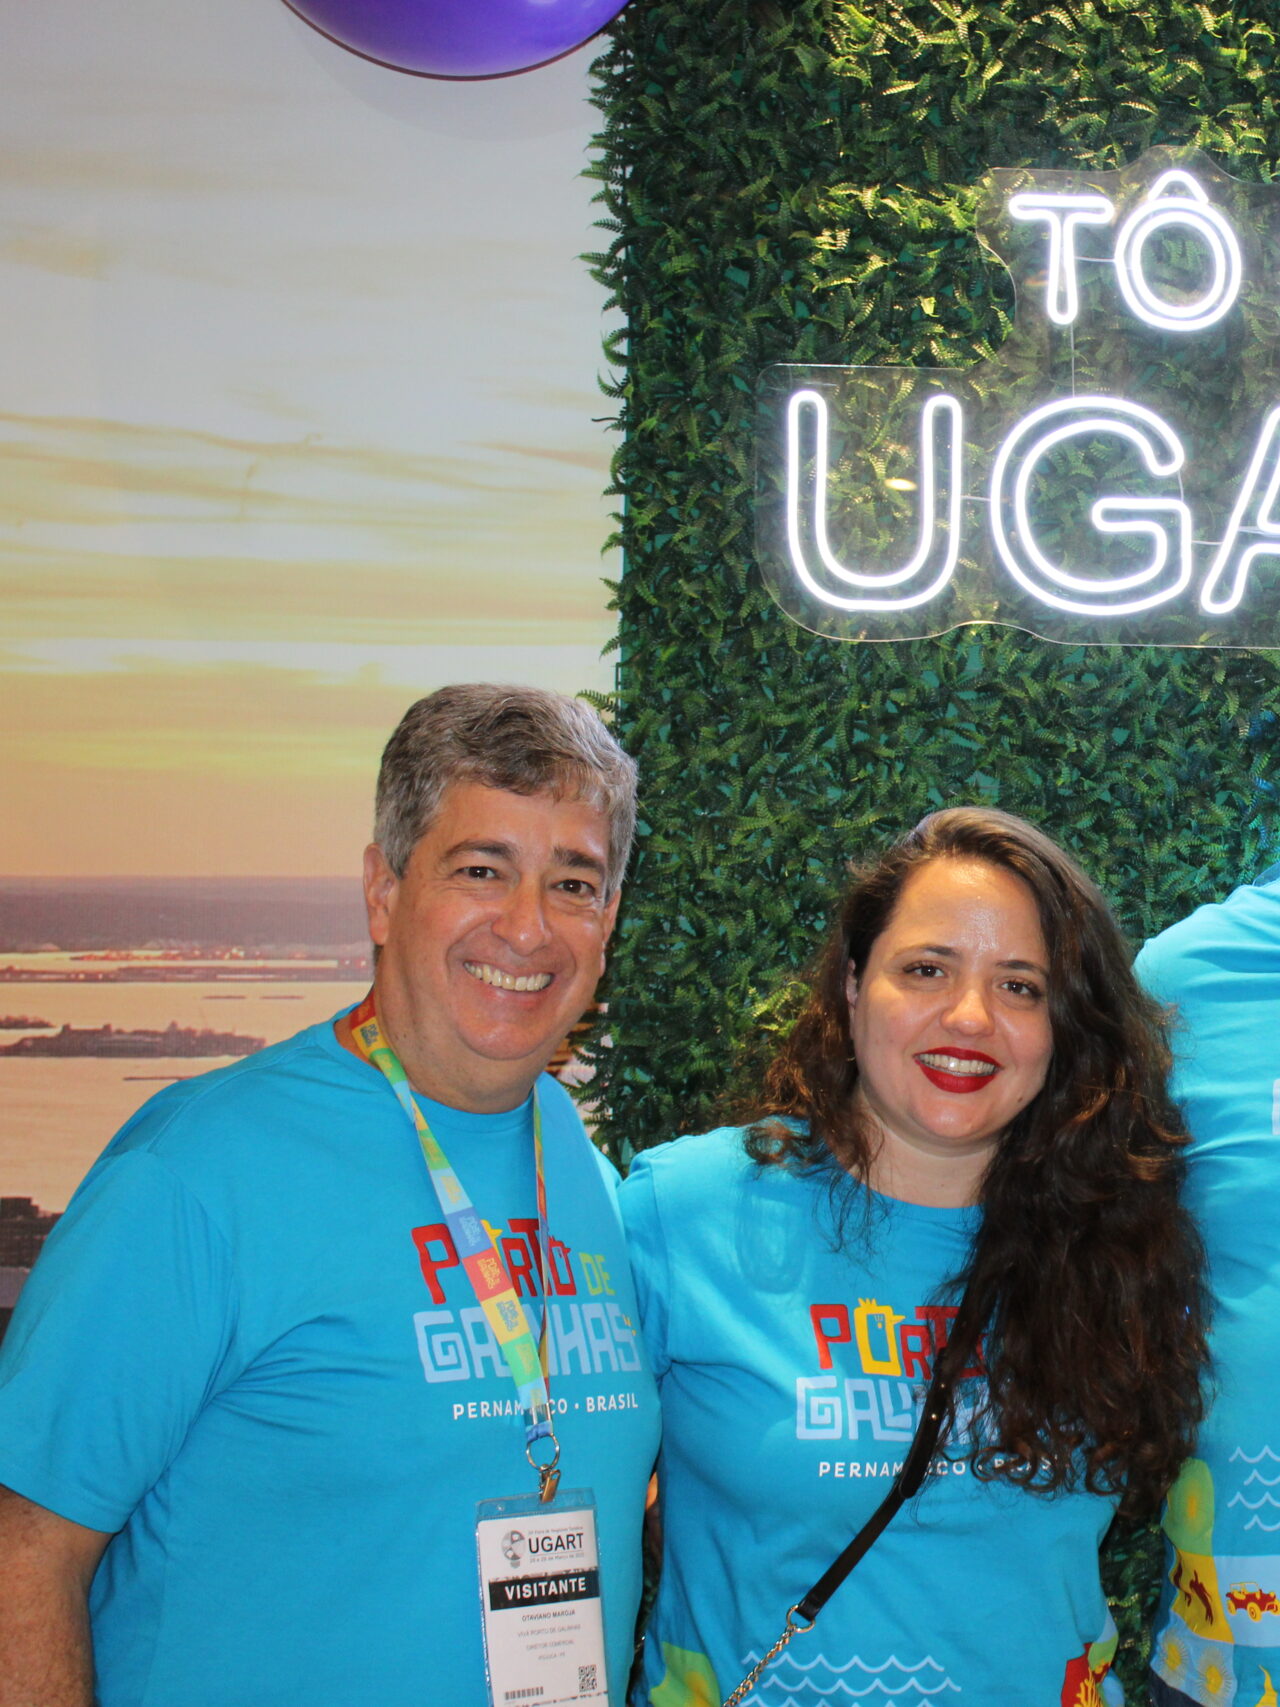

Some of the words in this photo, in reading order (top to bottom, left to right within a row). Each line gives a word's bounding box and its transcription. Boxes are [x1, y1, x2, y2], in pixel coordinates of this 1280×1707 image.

[1008, 169, 1243, 333] TÔ
[411, 1217, 577, 1304] PRTO
[577, 1252, 617, 1296] DE
[453, 1399, 568, 1421] PERNAMCO
[585, 1392, 639, 1413] BRASIL
[818, 1460, 967, 1478] PERNAMCO
[528, 1532, 584, 1554] UGART
[504, 1576, 587, 1601] VISITANTE
